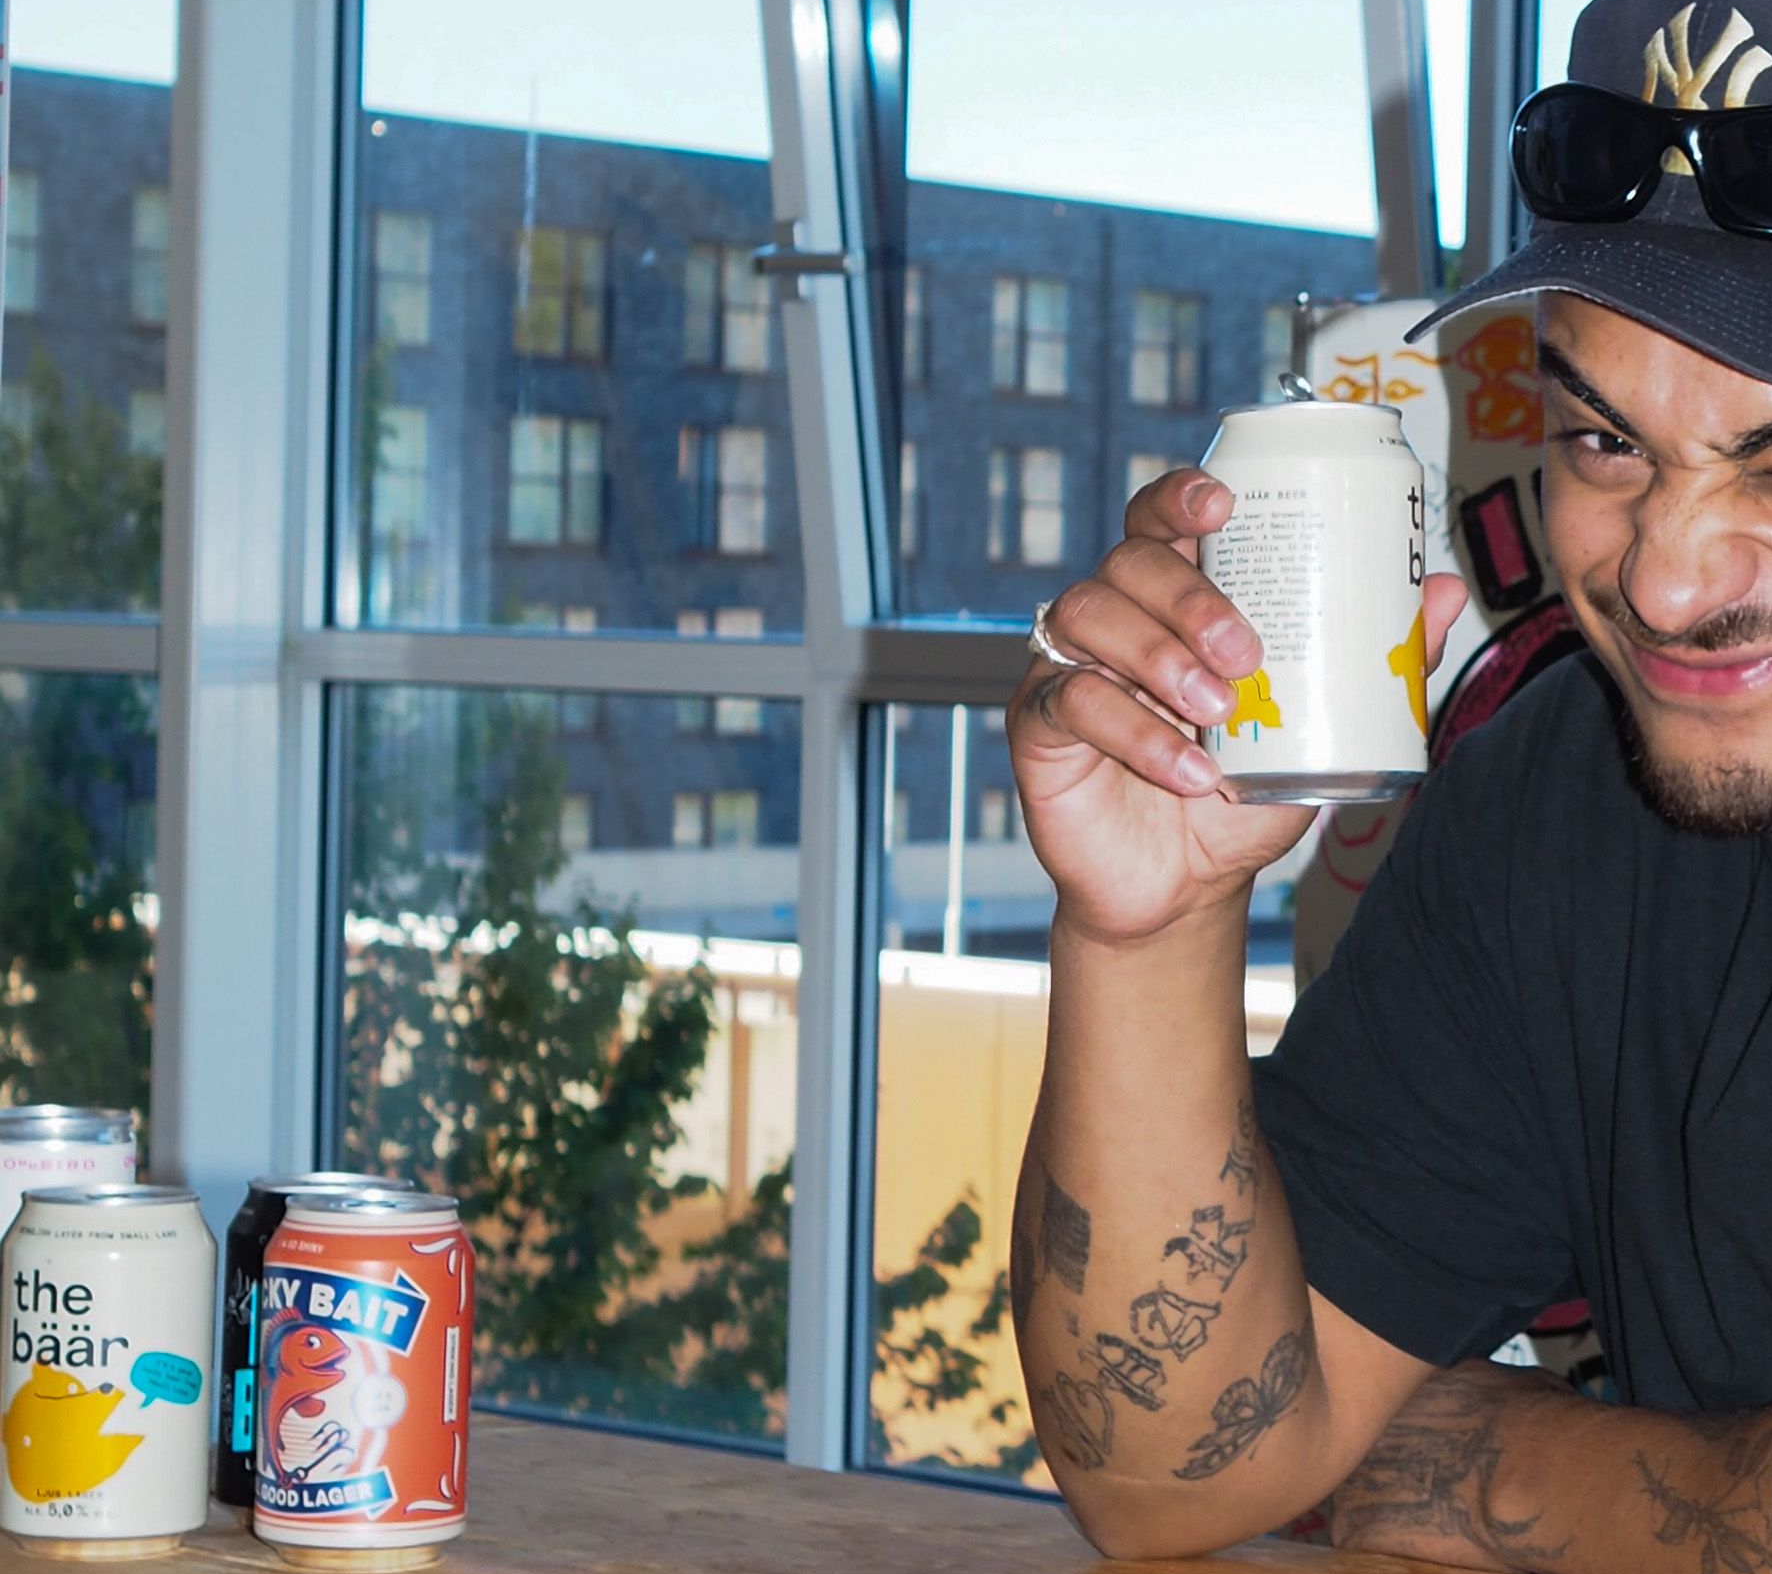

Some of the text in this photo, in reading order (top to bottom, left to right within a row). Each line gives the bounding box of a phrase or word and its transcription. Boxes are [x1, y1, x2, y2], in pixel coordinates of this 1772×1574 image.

[13, 1269, 94, 1315] the
[261, 1276, 409, 1335] CKY BAIT
[12, 1320, 129, 1369] bäär
[261, 1481, 299, 1508] GOOD
[303, 1481, 376, 1508] LAGER
